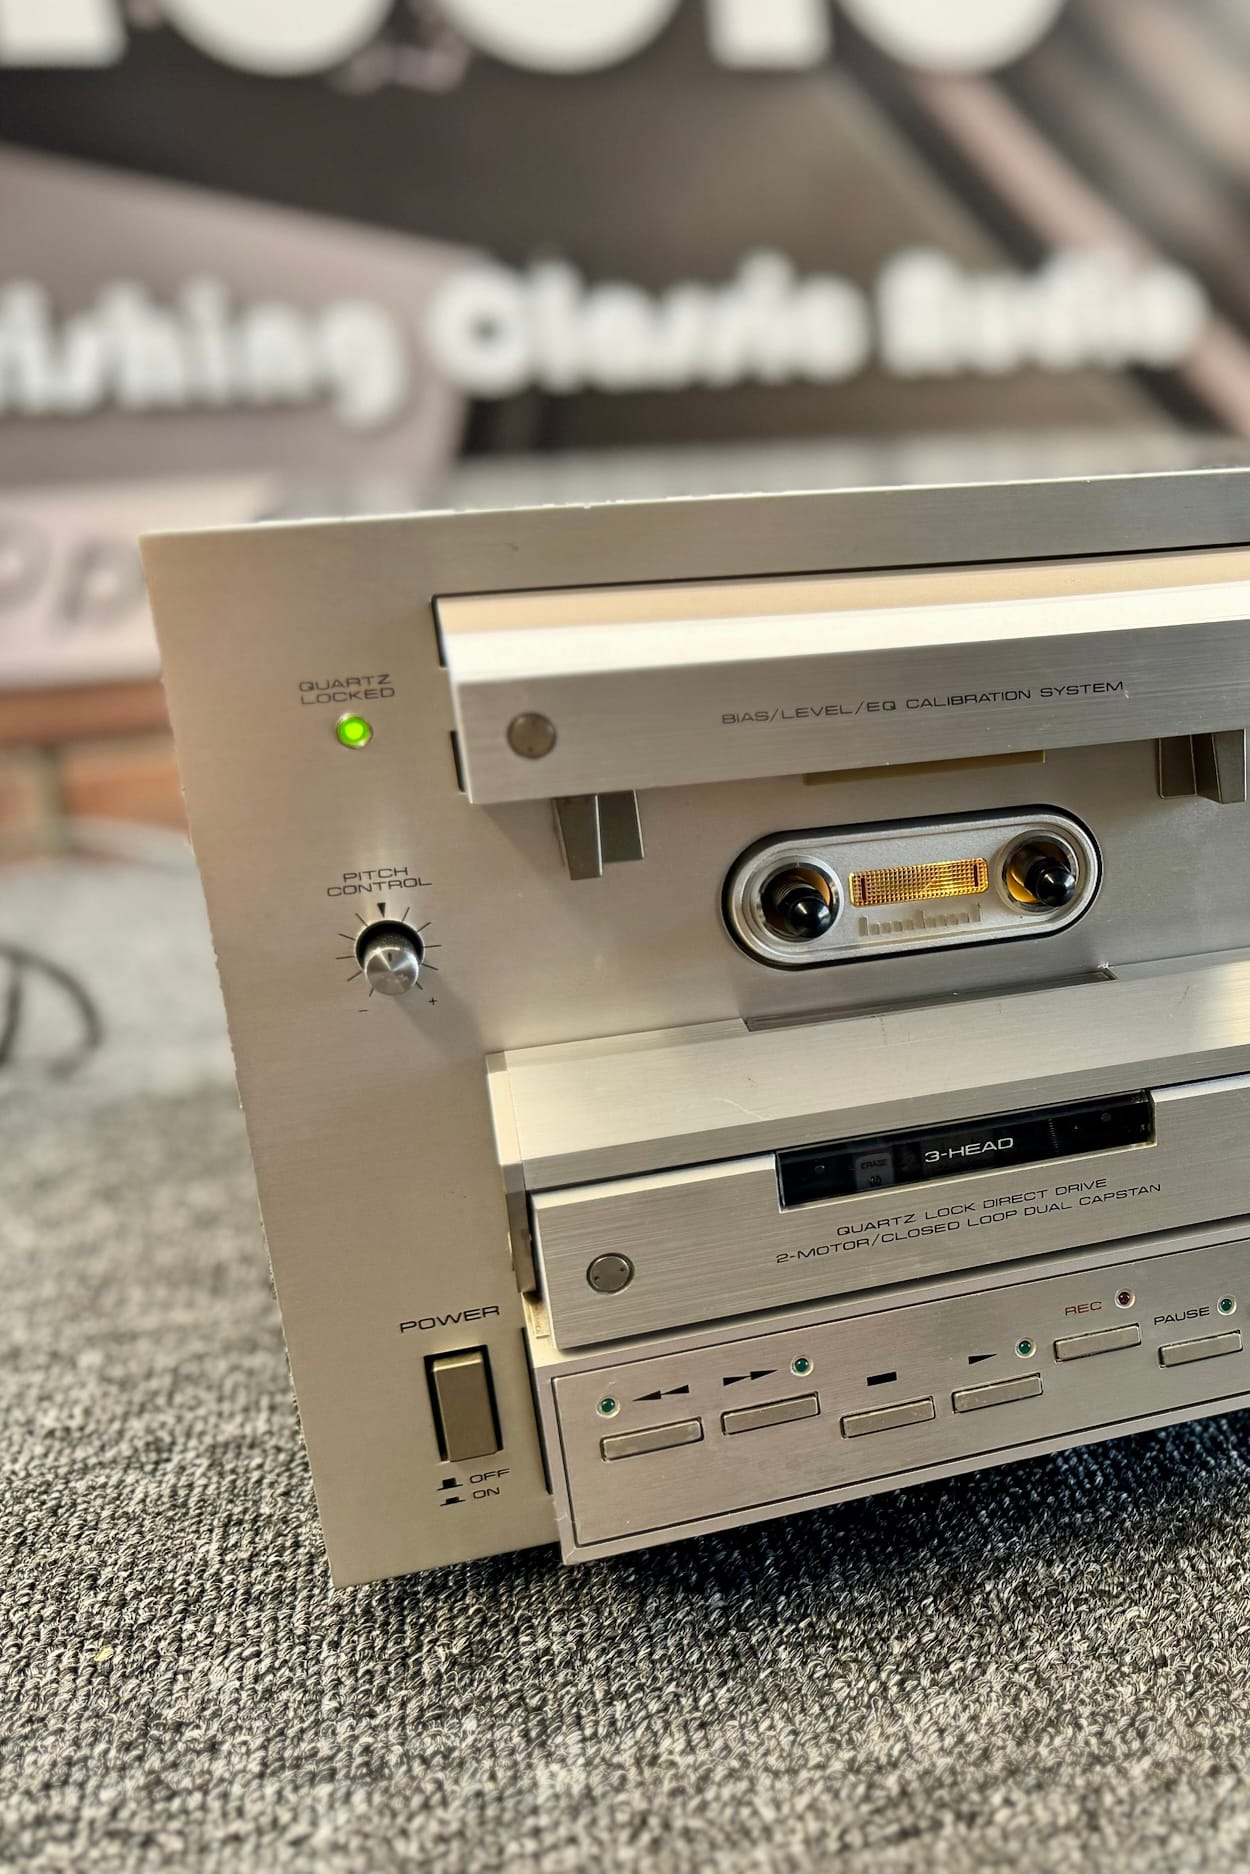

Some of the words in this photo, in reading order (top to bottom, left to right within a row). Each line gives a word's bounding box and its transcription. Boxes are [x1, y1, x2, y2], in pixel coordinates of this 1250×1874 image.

[298, 673, 392, 693] QUARTZ
[300, 687, 395, 705] LOCKED
[721, 699, 897, 725] BIAS/LEVEL/EQ
[905, 689, 1032, 710] CALIBRATION
[1039, 681, 1124, 699] SYSTEM
[342, 866, 409, 883] PITCH
[326, 877, 433, 897] CONTROL
[924, 1137, 1014, 1164] 3-HEAD
[836, 1213, 917, 1237] QUARTZ
[924, 1202, 976, 1220] LOCK
[983, 1189, 1048, 1208] DIRECT
[1055, 1178, 1108, 1196] DRIVE
[775, 1221, 960, 1264] 2-MOTOR/CLOSED
[967, 1209, 1018, 1228] LOOP
[1023, 1202, 1073, 1217] DUAL
[1078, 1183, 1162, 1206] CAPSTAN
[1064, 1301, 1103, 1316] REC
[1153, 1306, 1211, 1326] PAUSE
[400, 1305, 500, 1333] POWER
[469, 1468, 511, 1485] OFF
[472, 1487, 500, 1500] ON
